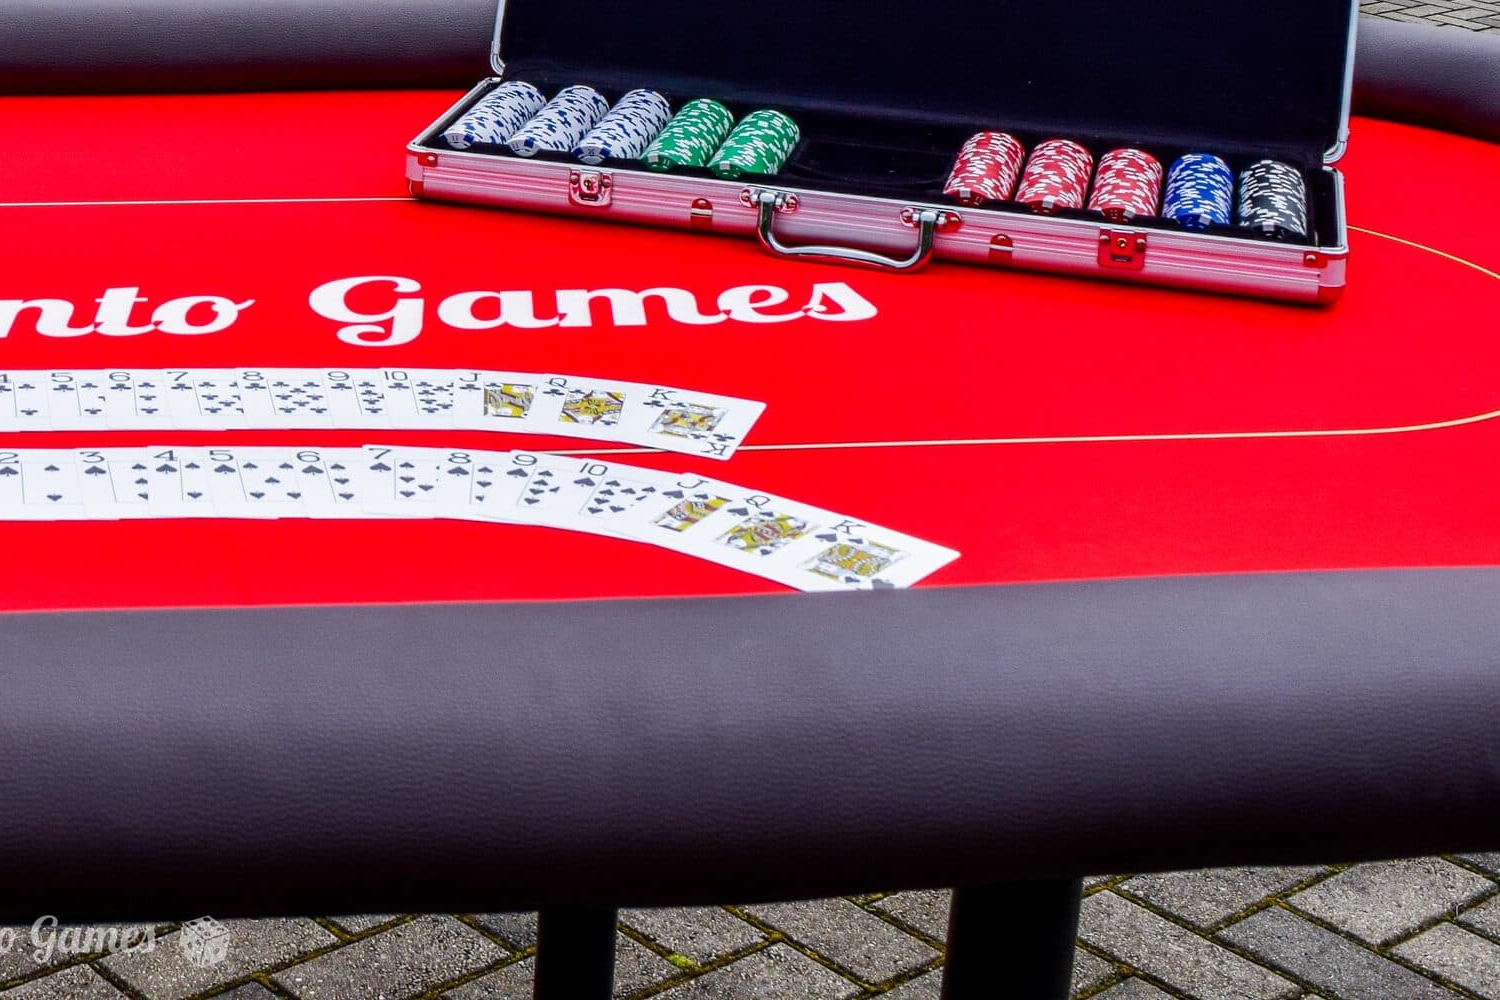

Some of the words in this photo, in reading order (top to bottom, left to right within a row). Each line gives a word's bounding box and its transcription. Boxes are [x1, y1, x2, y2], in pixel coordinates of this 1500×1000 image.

[309, 275, 878, 347] Games
[51, 372, 74, 382] 5
[108, 372, 131, 381] 6
[166, 371, 189, 381] 7
[242, 371, 265, 380] 8
[327, 371, 351, 381] 9
[384, 371, 409, 380] 10
[459, 372, 480, 381] J
[548, 377, 568, 388] Q
[649, 388, 677, 400] K
[79, 451, 105, 463] 3
[153, 450, 178, 461] 4
[209, 449, 234, 461] 5
[296, 450, 321, 462] 6
[368, 447, 392, 459] 7
[447, 452, 472, 464] 8
[512, 454, 538, 466] 9
[579, 462, 609, 475] 10
[676, 479, 710, 489] J
[745, 495, 771, 508] Q
[830, 519, 867, 535] K
